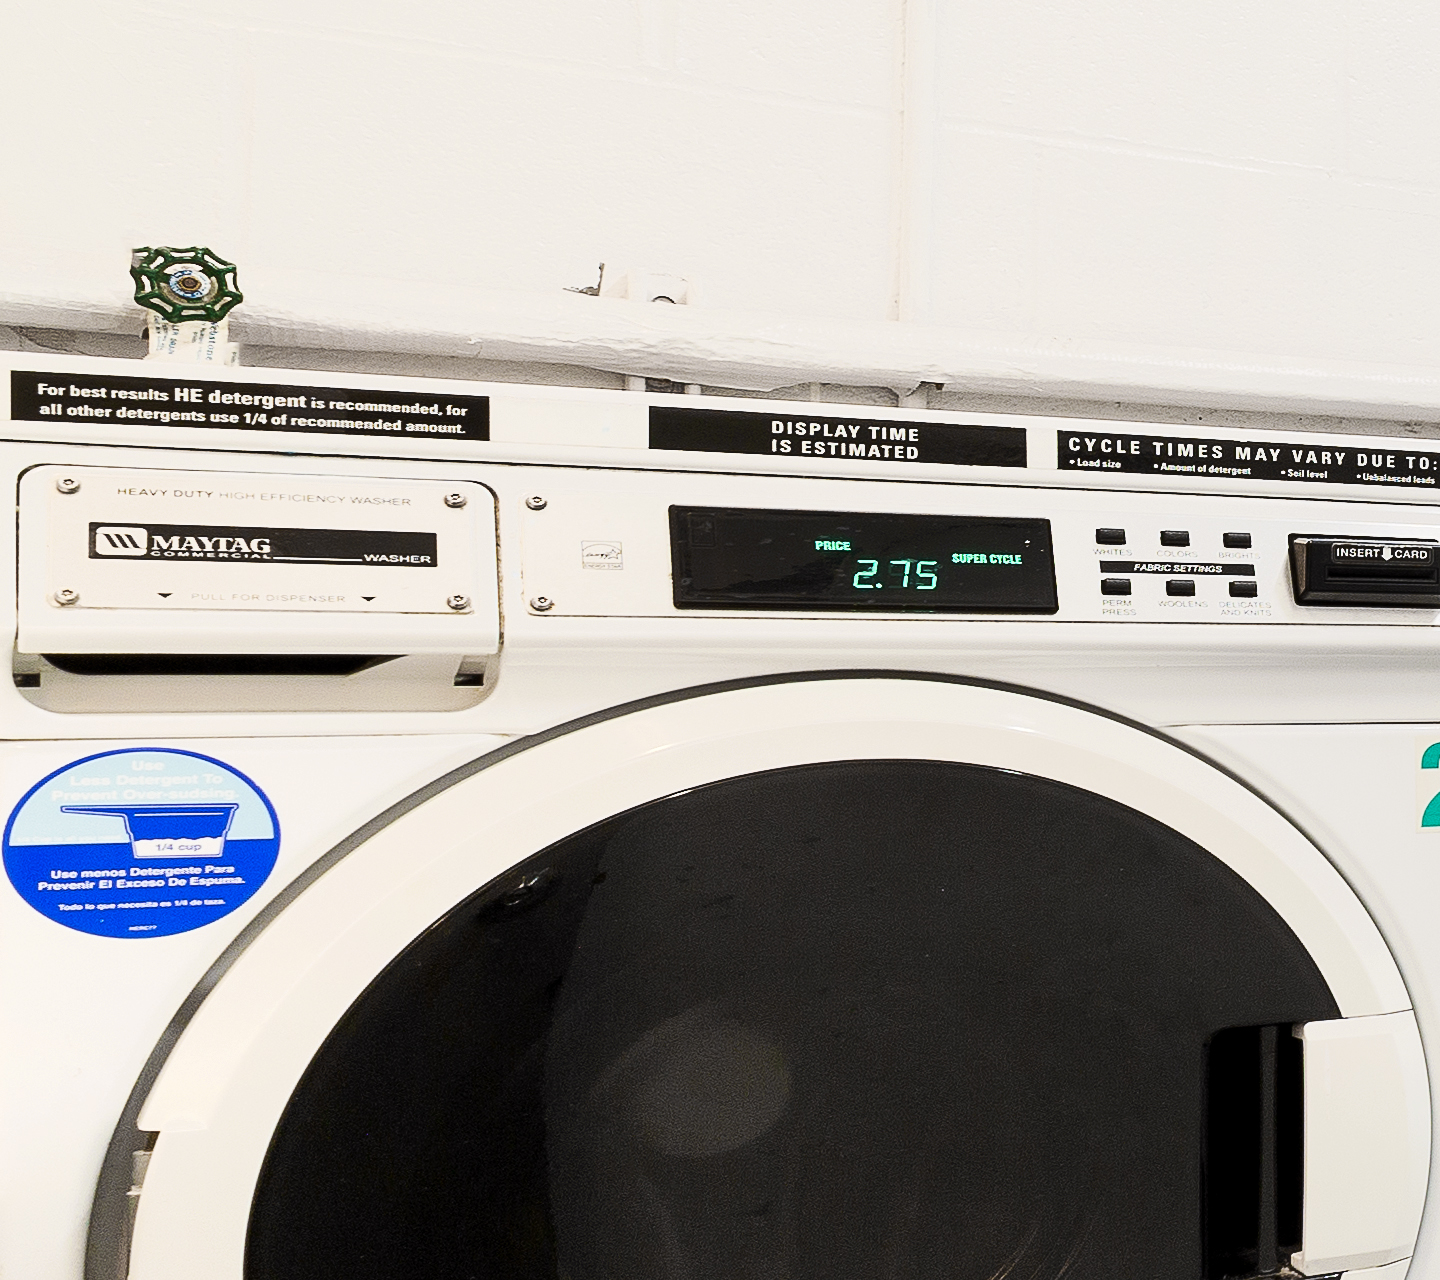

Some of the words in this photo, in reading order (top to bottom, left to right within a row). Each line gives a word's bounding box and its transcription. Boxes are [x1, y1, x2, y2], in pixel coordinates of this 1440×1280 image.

[37, 382, 66, 397] For
[70, 384, 107, 400] best
[111, 388, 169, 403] results
[174, 387, 203, 403] HE
[208, 389, 306, 410] detergent
[311, 396, 325, 409] is
[329, 398, 442, 418] recommended,
[446, 403, 468, 417] for
[39, 403, 62, 416] all
[66, 405, 111, 419] other
[116, 407, 206, 424] detergents
[210, 411, 238, 424] use
[243, 412, 267, 425] 1/4
[271, 413, 288, 426] of
[290, 415, 401, 432] recommended
[405, 421, 466, 434] amount.
[771, 421, 859, 439] DISPLAY
[868, 426, 919, 442] TIME
[771, 439, 792, 453] IS
[801, 441, 919, 459] ESTIMATED
[1068, 437, 1141, 456] CYCLE
[1153, 441, 1224, 459] TIMES
[1235, 447, 1281, 462] MAY
[1292, 450, 1346, 466] VARY
[1357, 453, 1397, 469] DUE
[1406, 456, 1439, 471] TO:
[152, 536, 271, 553] MAYTAG
[815, 540, 851, 551] PRICE
[1336, 547, 1381, 559] INSERT
[1394, 548, 1428, 560] CARD
[363, 553, 431, 564] WASHER
[952, 552, 987, 564] SUPER
[989, 554, 1023, 565] CYCLE
[853, 559, 938, 589] 2.75
